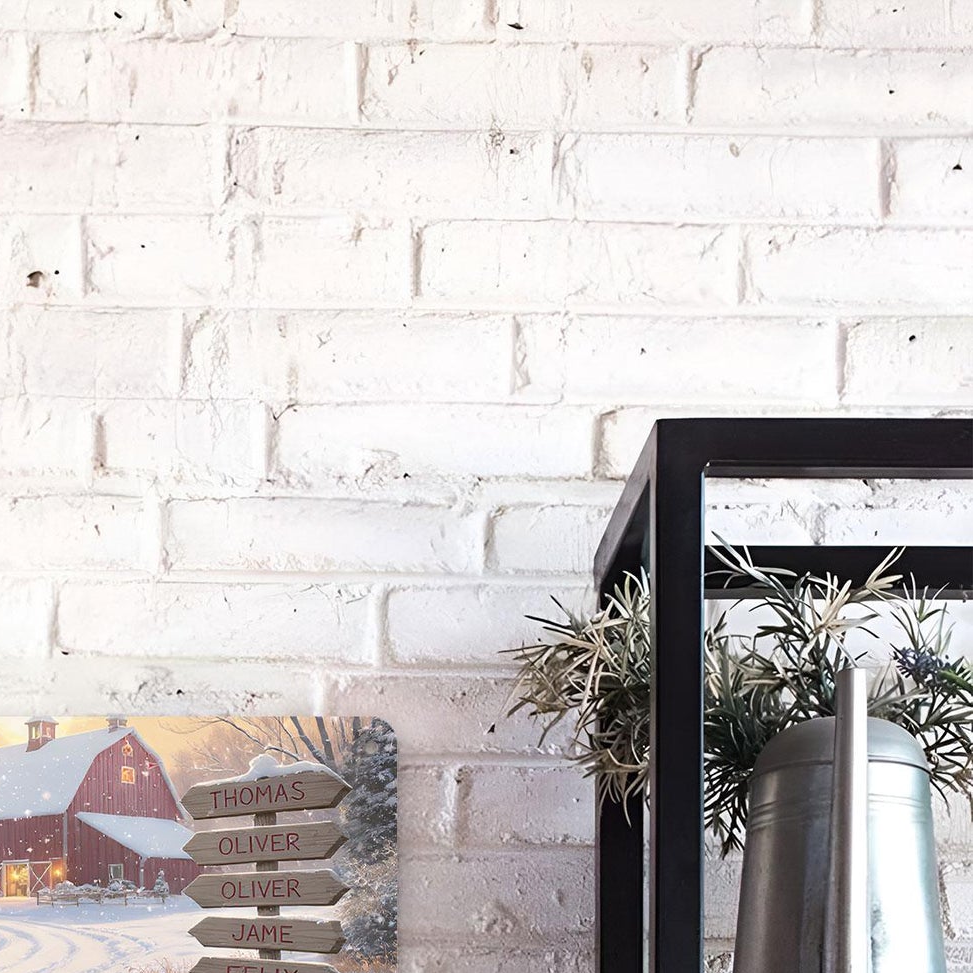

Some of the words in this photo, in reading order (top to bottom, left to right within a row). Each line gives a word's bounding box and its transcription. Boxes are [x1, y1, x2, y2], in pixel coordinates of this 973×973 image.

[210, 781, 306, 809] THOMAS
[218, 832, 300, 856] OLIVER
[221, 879, 301, 900] OLIVER
[232, 923, 294, 944] JAME
